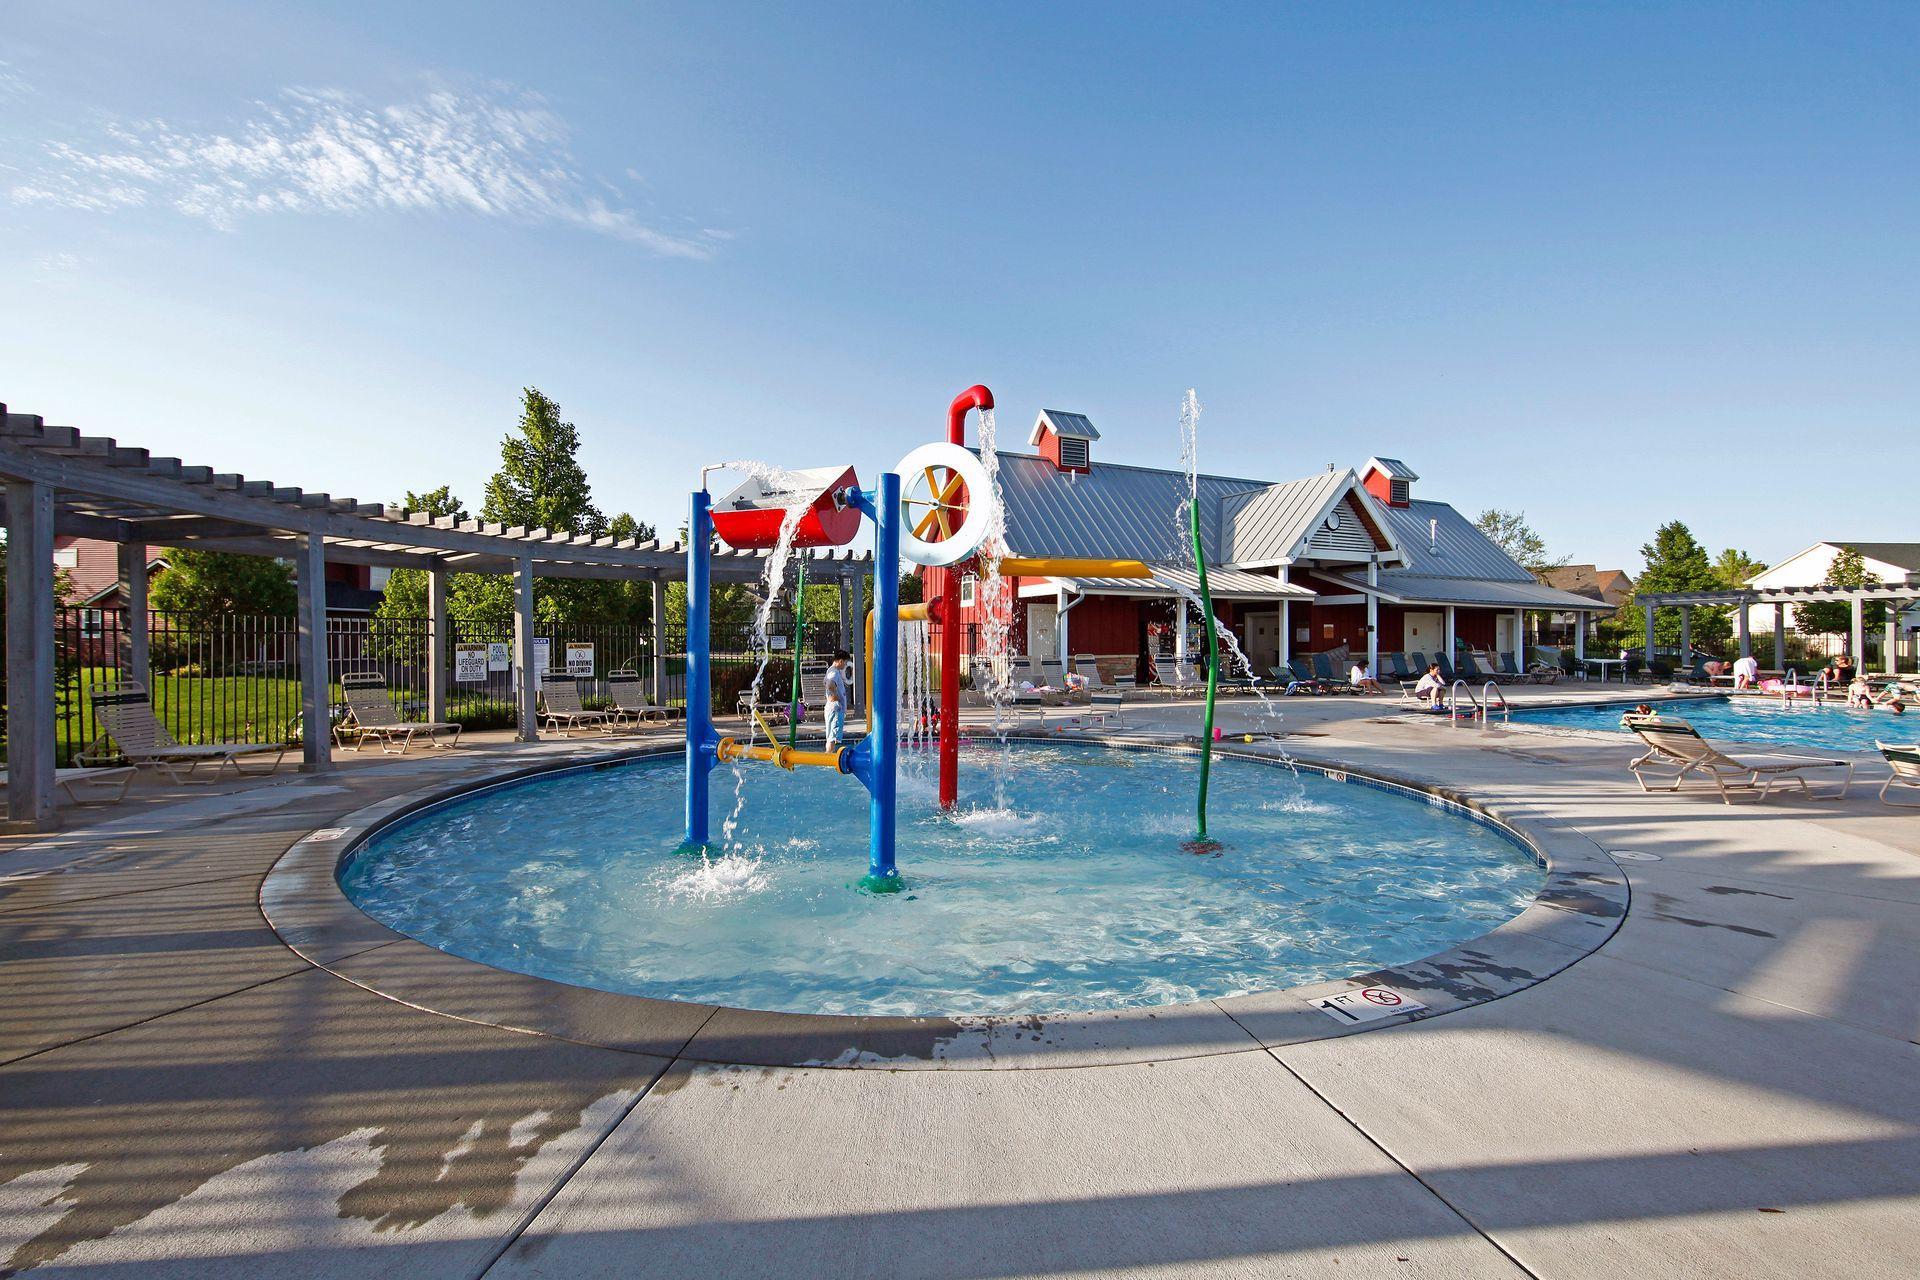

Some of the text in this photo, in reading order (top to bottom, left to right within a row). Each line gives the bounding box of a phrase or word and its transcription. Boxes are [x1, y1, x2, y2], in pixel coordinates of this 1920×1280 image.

[492, 645, 505, 653] POOL
[491, 653, 507, 662] CAPACITY
[1334, 995, 1354, 1005] FT
[1320, 1000, 1360, 1021] 1
